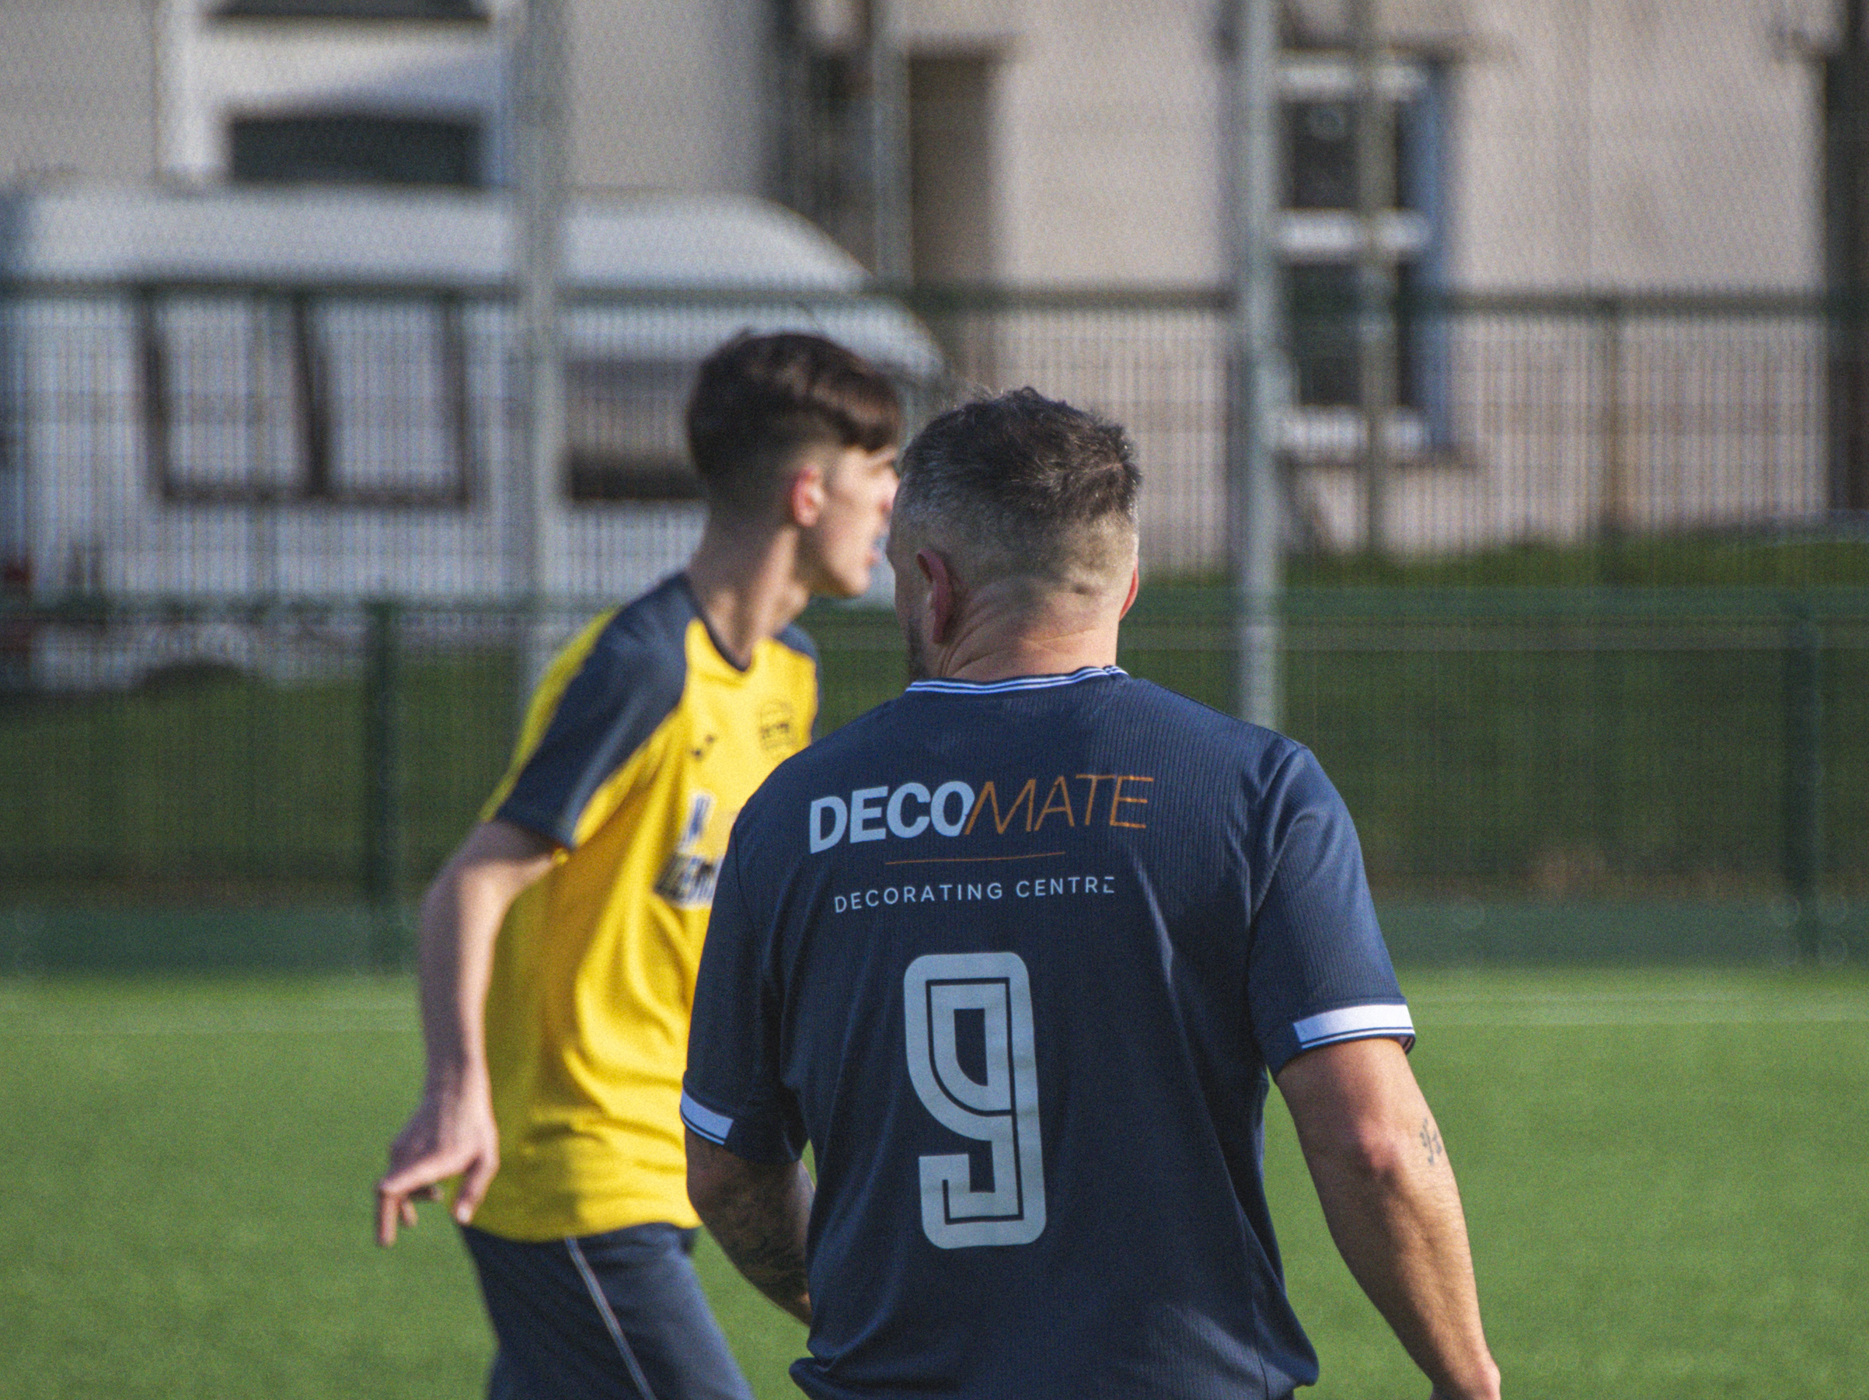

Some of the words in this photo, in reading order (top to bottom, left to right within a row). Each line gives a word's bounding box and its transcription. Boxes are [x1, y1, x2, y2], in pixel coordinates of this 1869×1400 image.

[809, 774, 1154, 855] DECOMATE
[834, 883, 1003, 913] DECORATING
[904, 952, 1047, 1249] 9
